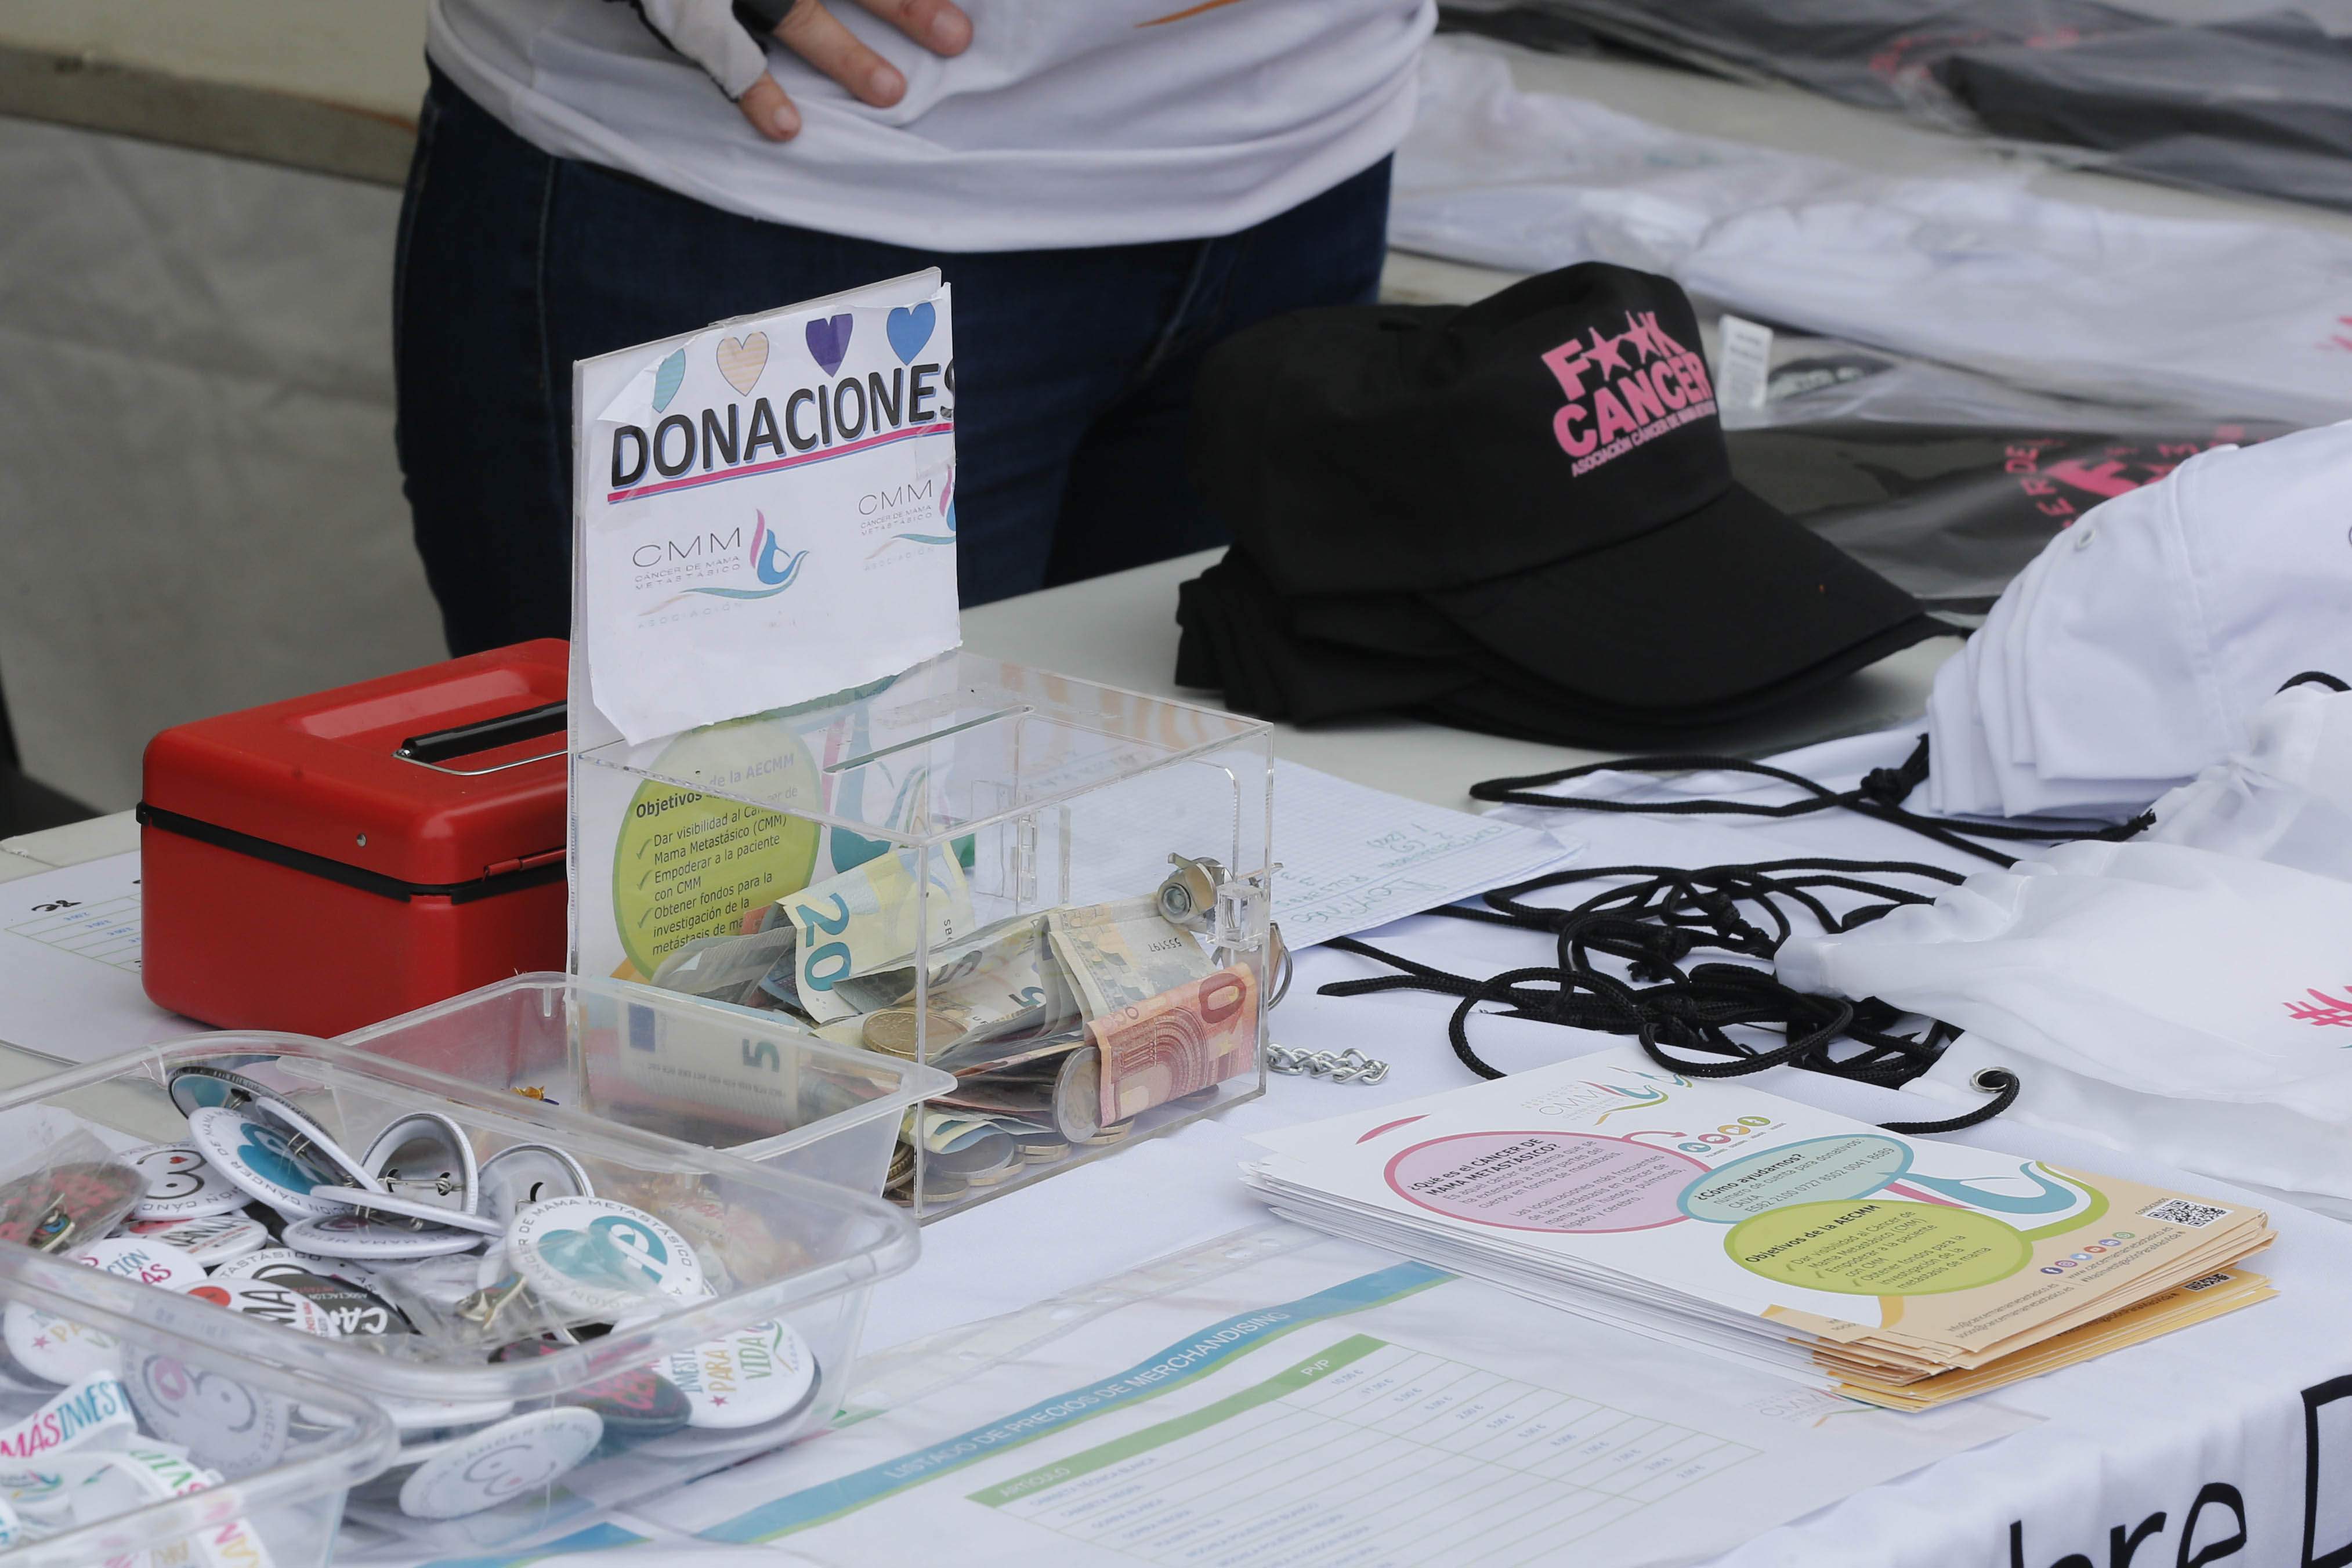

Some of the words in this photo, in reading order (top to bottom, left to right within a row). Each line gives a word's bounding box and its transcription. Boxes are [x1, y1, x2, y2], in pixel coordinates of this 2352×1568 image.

[1553, 351, 1713, 457] CANCER
[858, 479, 932, 516] CMM
[633, 527, 740, 567] CMM
[636, 791, 703, 819] Objetivos
[729, 770, 742, 784] la
[746, 753, 795, 780] AECMM
[653, 832, 673, 847] Dar
[676, 814, 728, 840] visibilidad
[731, 807, 740, 823] al
[654, 847, 687, 866] Mama
[690, 826, 750, 854] Metastásico
[754, 814, 787, 836] (CMM)
[654, 856, 712, 883] Empoderar
[714, 853, 721, 864] a
[725, 848, 733, 861] la
[737, 834, 780, 859] paciente
[654, 888, 673, 901] con
[677, 876, 701, 895] CMM
[654, 899, 697, 919] Obtener
[700, 885, 734, 905] fondos
[737, 877, 760, 892] para
[764, 872, 773, 883] la
[653, 907, 722, 938] investigación
[725, 901, 737, 914] de
[741, 897, 750, 910] la
[713, 922, 726, 936] de
[742, 1038, 780, 1073] 5
[1408, 1175, 1444, 1191] ¿Qué
[1442, 1170, 1460, 1178] es
[1470, 1145, 1524, 1167] CÁNCER
[1520, 1138, 1544, 1147] DE
[1425, 1179, 1470, 1196] MAMA
[1465, 1143, 1561, 1180] METASTÁSICO?
[1459, 1182, 1486, 1196] aquel
[1485, 1169, 1519, 1185] cáncer
[1518, 1164, 1535, 1173] de
[1532, 1153, 1564, 1167] mama
[1562, 1146, 1582, 1156] que
[1582, 1140, 1597, 1148] se
[1475, 1179, 1525, 1200] extendido
[1530, 1165, 1559, 1179] otras
[1556, 1153, 1589, 1169] partes
[1586, 1146, 1605, 1156] del
[1528, 1183, 1595, 1210] localizaciones
[1592, 1175, 1616, 1185] más
[1611, 1154, 1665, 1176] frecuentes
[1694, 1182, 1739, 1200] ¿Cómo
[1736, 1153, 1806, 1183] ayudarnos?
[1713, 1189, 1752, 1205] número
[1750, 1182, 1766, 1190] de
[1763, 1169, 1797, 1184] cuenta
[1794, 1160, 1818, 1172] para
[1815, 1138, 1865, 1161] donativos:
[1478, 1193, 1514, 1209] cuerpo
[1511, 1187, 1527, 1196] en
[1523, 1176, 1557, 1192] forma
[1554, 1171, 1571, 1179] de
[1528, 1213, 1544, 1222] de
[1541, 1207, 1560, 1216] las
[1557, 1187, 1611, 1210] metástasis
[1607, 1182, 1625, 1190] en
[1621, 1169, 1655, 1185] cáncer
[1652, 1163, 1669, 1171] de
[1728, 1195, 1764, 1208] CAIXA
[518, 1217, 535, 1234] DE
[531, 1198, 581, 1217] MAMA
[1544, 1211, 1577, 1226] mama
[1745, 1236, 1807, 1263] Objetivos
[1805, 1229, 1824, 1238] de
[1833, 1204, 1881, 1225] AECMM
[1790, 1255, 1810, 1265] Dar
[1811, 1234, 1860, 1256] visibilidad
[1865, 1216, 1902, 1233] Cáncer
[1900, 1210, 1917, 1218] de
[1808, 1254, 1838, 1269] Mama
[1837, 1232, 1895, 1256] Metastásico
[1890, 1217, 1927, 1233] (CMM)
[1825, 1250, 1879, 1273] Empoderar
[1896, 1223, 1938, 1244] paciente
[1860, 1262, 1902, 1281] Obtener
[1898, 1248, 1934, 1265] fondos
[1931, 1239, 1957, 1251] para
[1844, 1269, 1863, 1278] con
[1861, 1257, 1890, 1269] CMM
[1878, 1258, 1941, 1285] investigación
[1938, 1252, 1955, 1260] de
[1897, 1265, 1950, 1290] metástasis
[1946, 1260, 1963, 1268] de
[1960, 1247, 1993, 1262] mama
[701, 1349, 738, 1393] PARA
[736, 1335, 773, 1380] VIDA
[972, 1429, 1012, 1444] DE
[1003, 1390, 1101, 1433] PRECIOS
[1097, 1383, 1133, 1399] DE
[1124, 1310, 1291, 1388] MERCHANDISING
[1300, 1358, 1331, 1377] PVP
